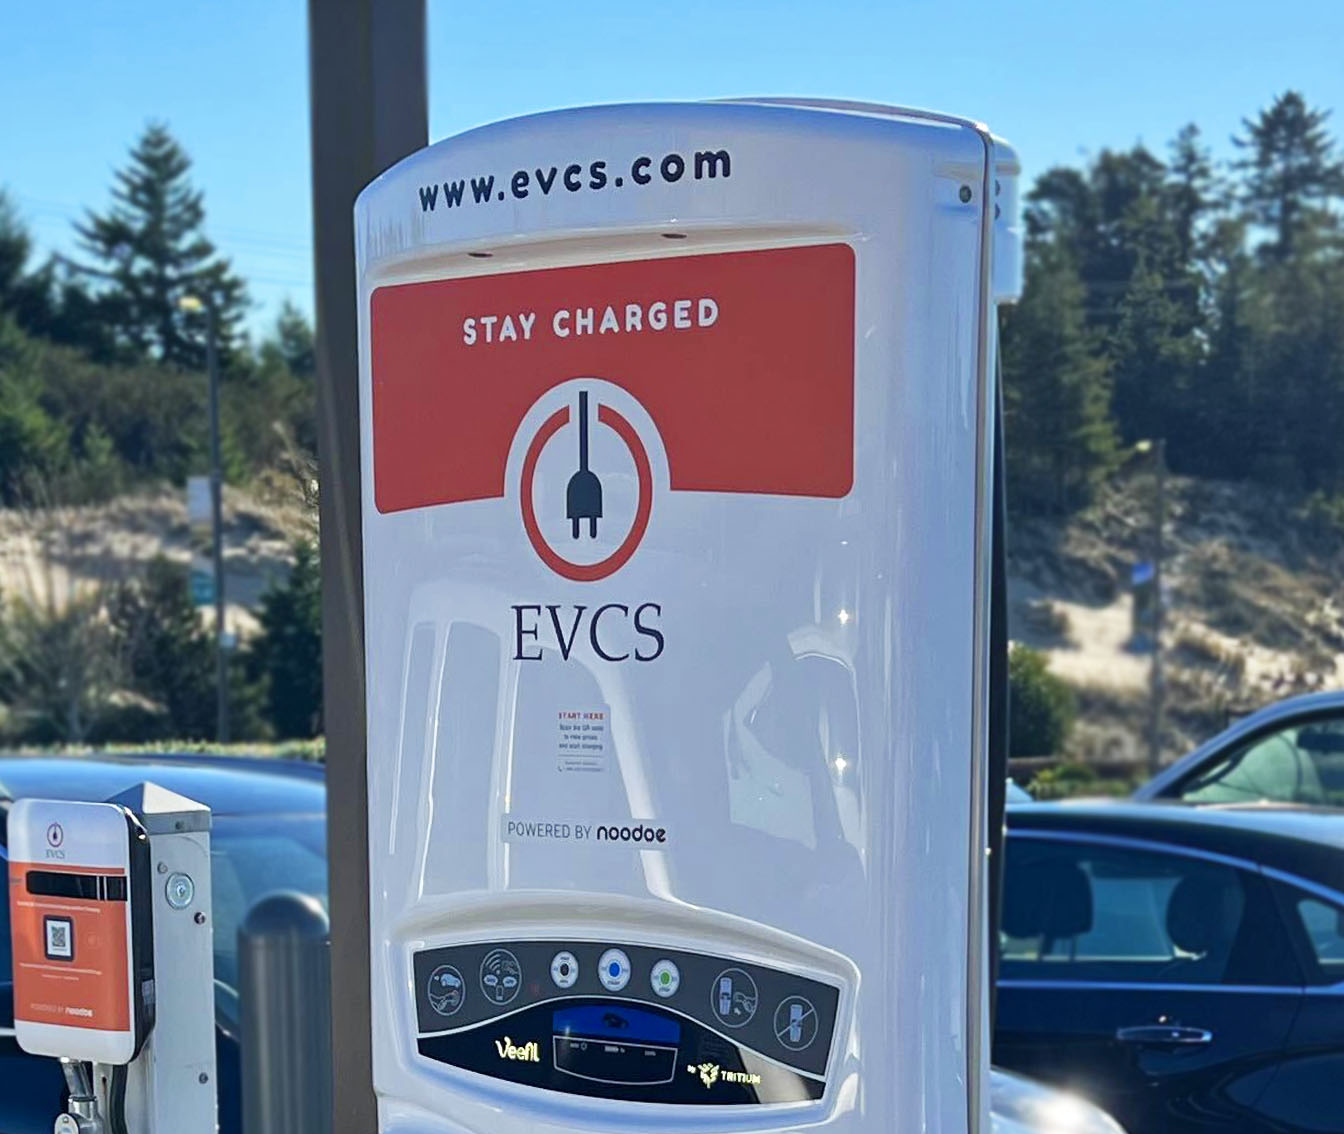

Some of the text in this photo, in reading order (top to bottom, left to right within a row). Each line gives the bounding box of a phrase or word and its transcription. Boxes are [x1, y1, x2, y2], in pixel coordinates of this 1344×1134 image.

[419, 149, 731, 212] www.evcs.com
[463, 298, 718, 345] STAY CHARGED
[511, 603, 665, 662] EVCS
[508, 821, 666, 843] POWERED BY noodoe
[721, 1069, 761, 1085] TRITIUM
